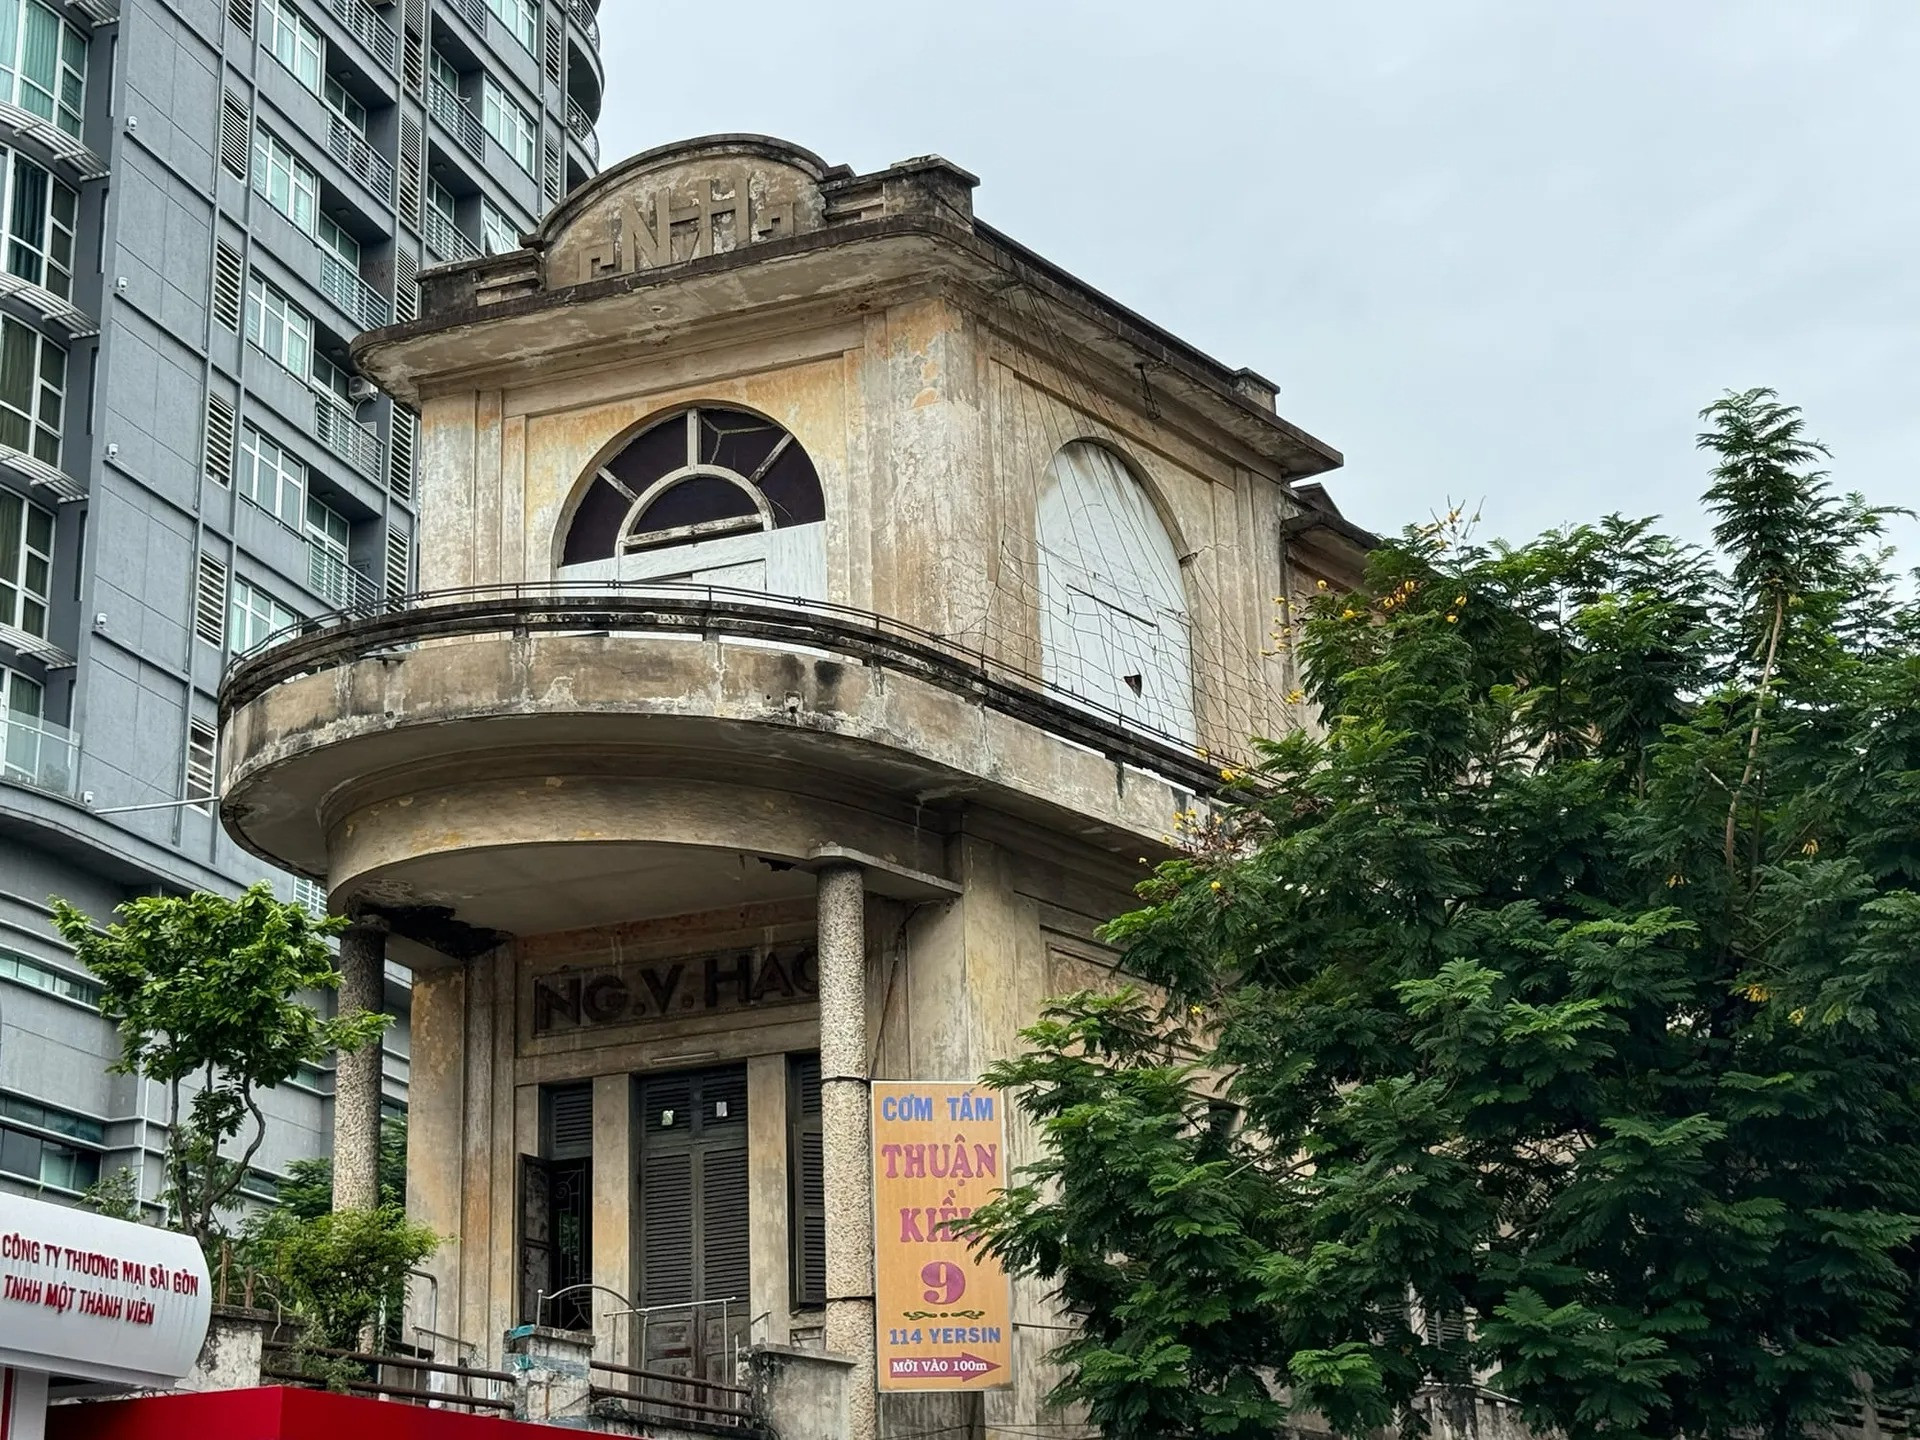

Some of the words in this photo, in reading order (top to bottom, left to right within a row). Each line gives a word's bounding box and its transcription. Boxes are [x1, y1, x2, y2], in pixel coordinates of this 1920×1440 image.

[882, 1094, 933, 1121] CƠM
[946, 1088, 994, 1121] TẤM
[881, 1133, 997, 1187] THUẬN
[2, 1232, 41, 1264] CÔNG
[44, 1243, 63, 1269] TY
[64, 1248, 119, 1280] THƯƠNG
[122, 1261, 146, 1290] MẠI
[150, 1263, 170, 1291] SÀI
[173, 1268, 199, 1297] GÒN
[920, 1261, 966, 1305] 9
[3, 1274, 43, 1304] TNHH
[45, 1281, 77, 1315] MỘT
[78, 1287, 123, 1320] THÀNH
[125, 1298, 156, 1325] VIÊN
[889, 1328, 923, 1345] 114
[928, 1327, 1001, 1344] YERSIN
[921, 1358, 949, 1372] VÀO
[953, 1360, 988, 1372] 100m
